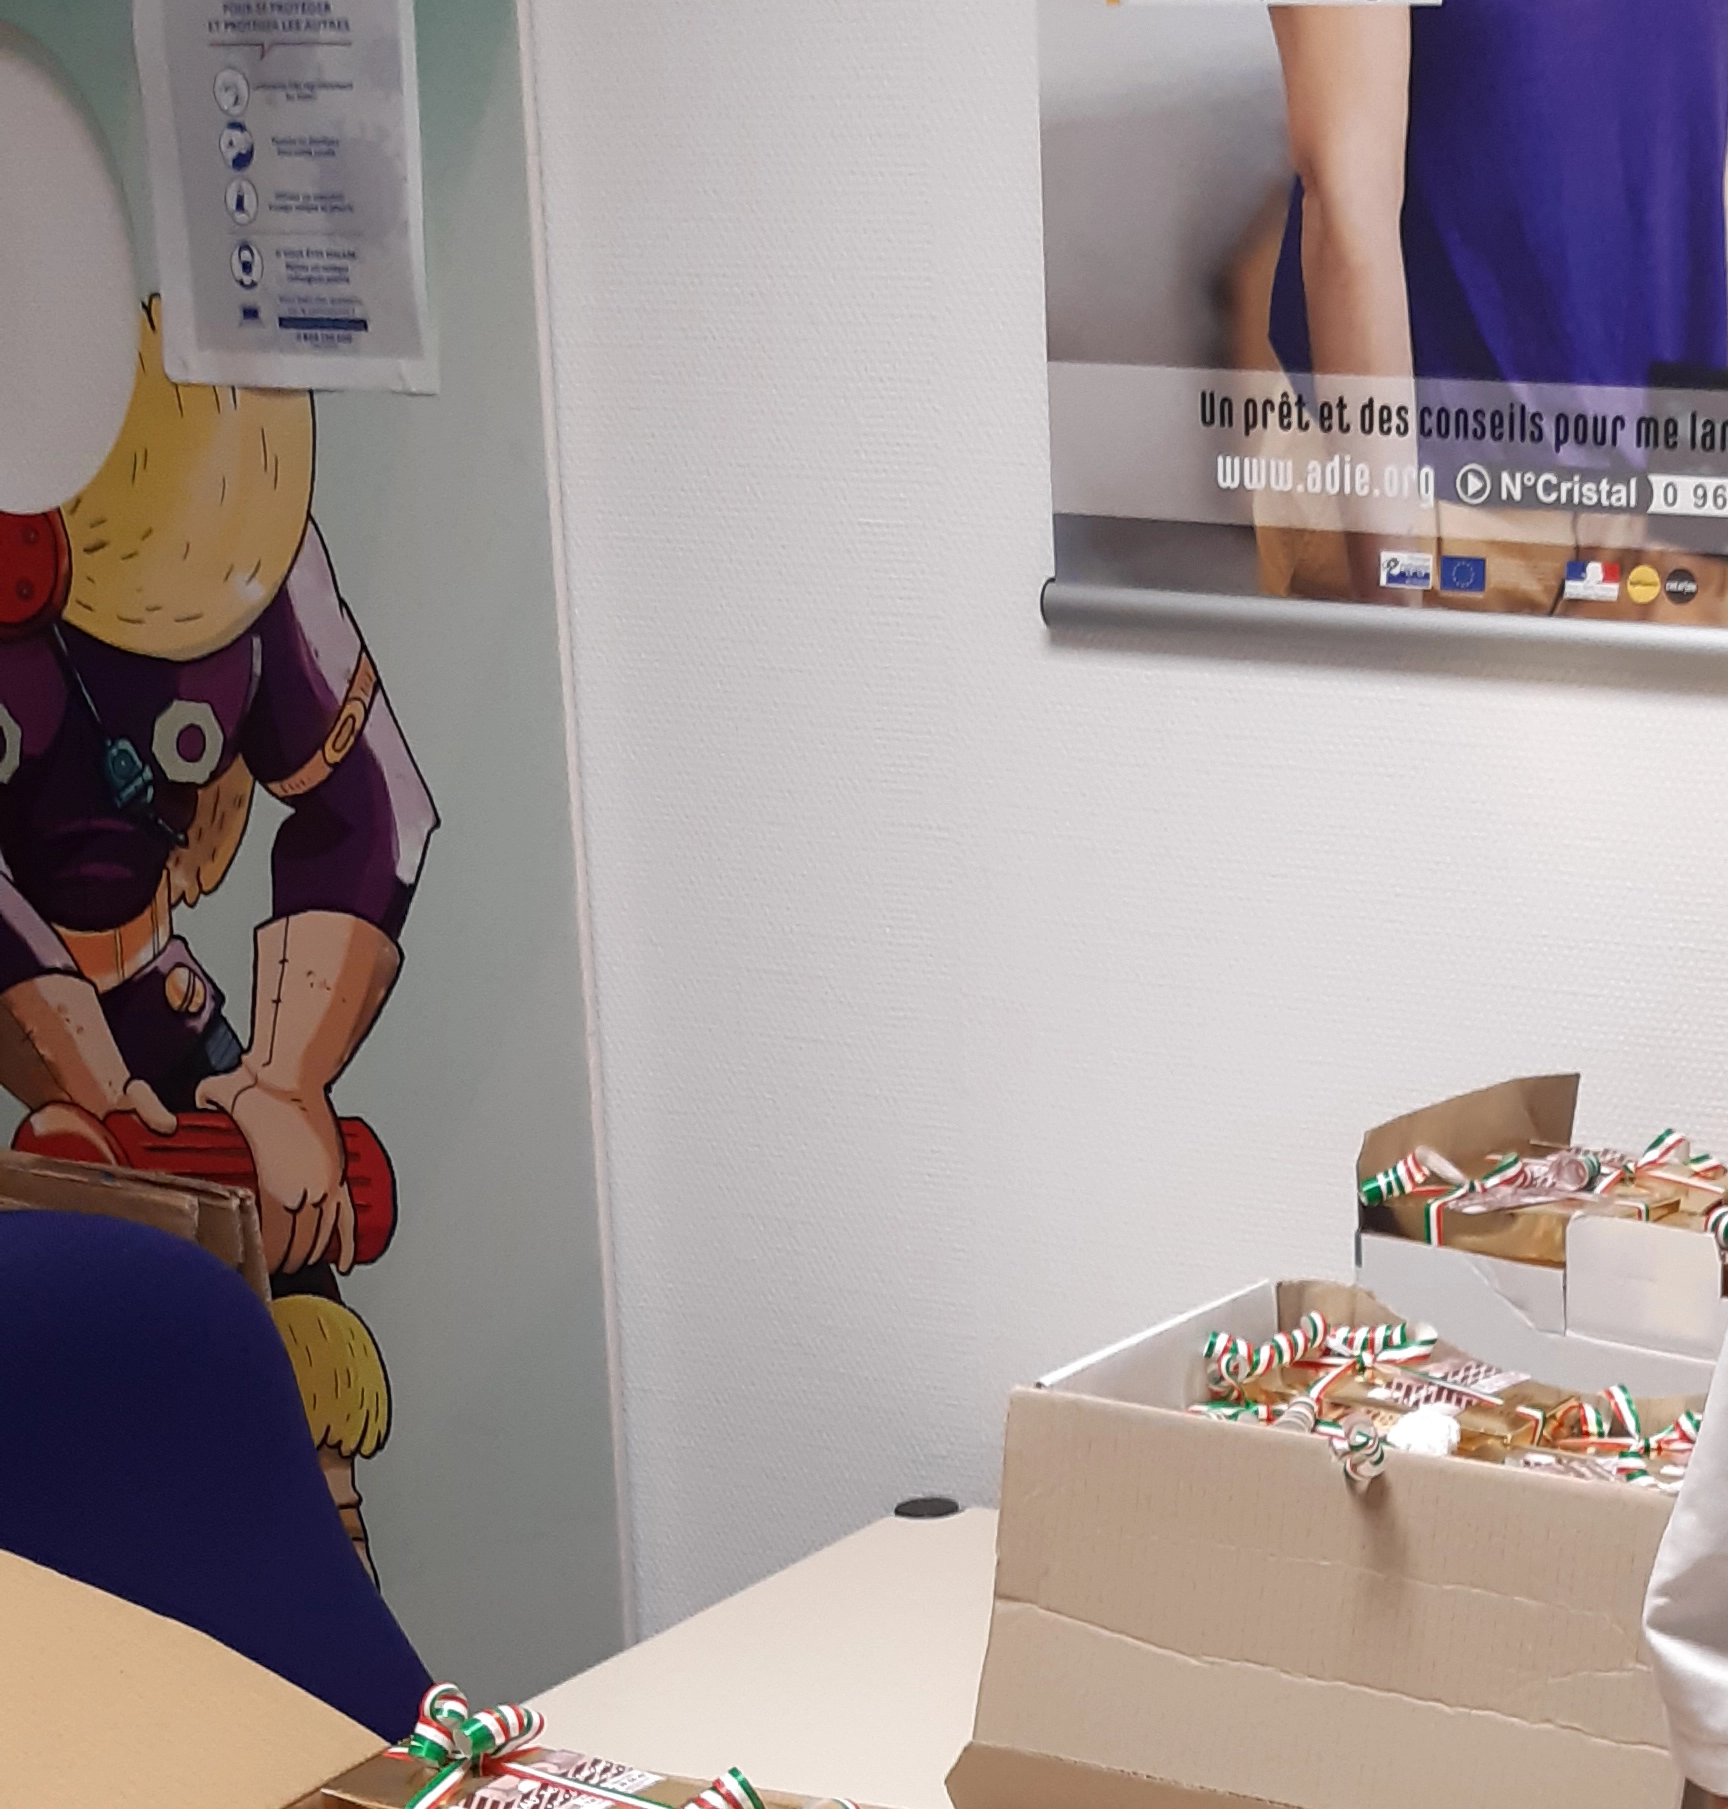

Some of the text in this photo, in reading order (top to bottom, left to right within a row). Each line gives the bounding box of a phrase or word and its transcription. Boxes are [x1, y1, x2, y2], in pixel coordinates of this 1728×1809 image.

[1200, 390, 1233, 428] Un
[1244, 391, 1310, 437] prêt
[1318, 395, 1350, 434] et
[1359, 396, 1409, 437] des
[1419, 403, 1544, 443] conseils
[1554, 411, 1625, 453] pour
[1636, 415, 1679, 452] me
[1216, 453, 1436, 508] www.adie.org
[1500, 469, 1638, 509] N°Cristal
[1662, 481, 1679, 508] 0
